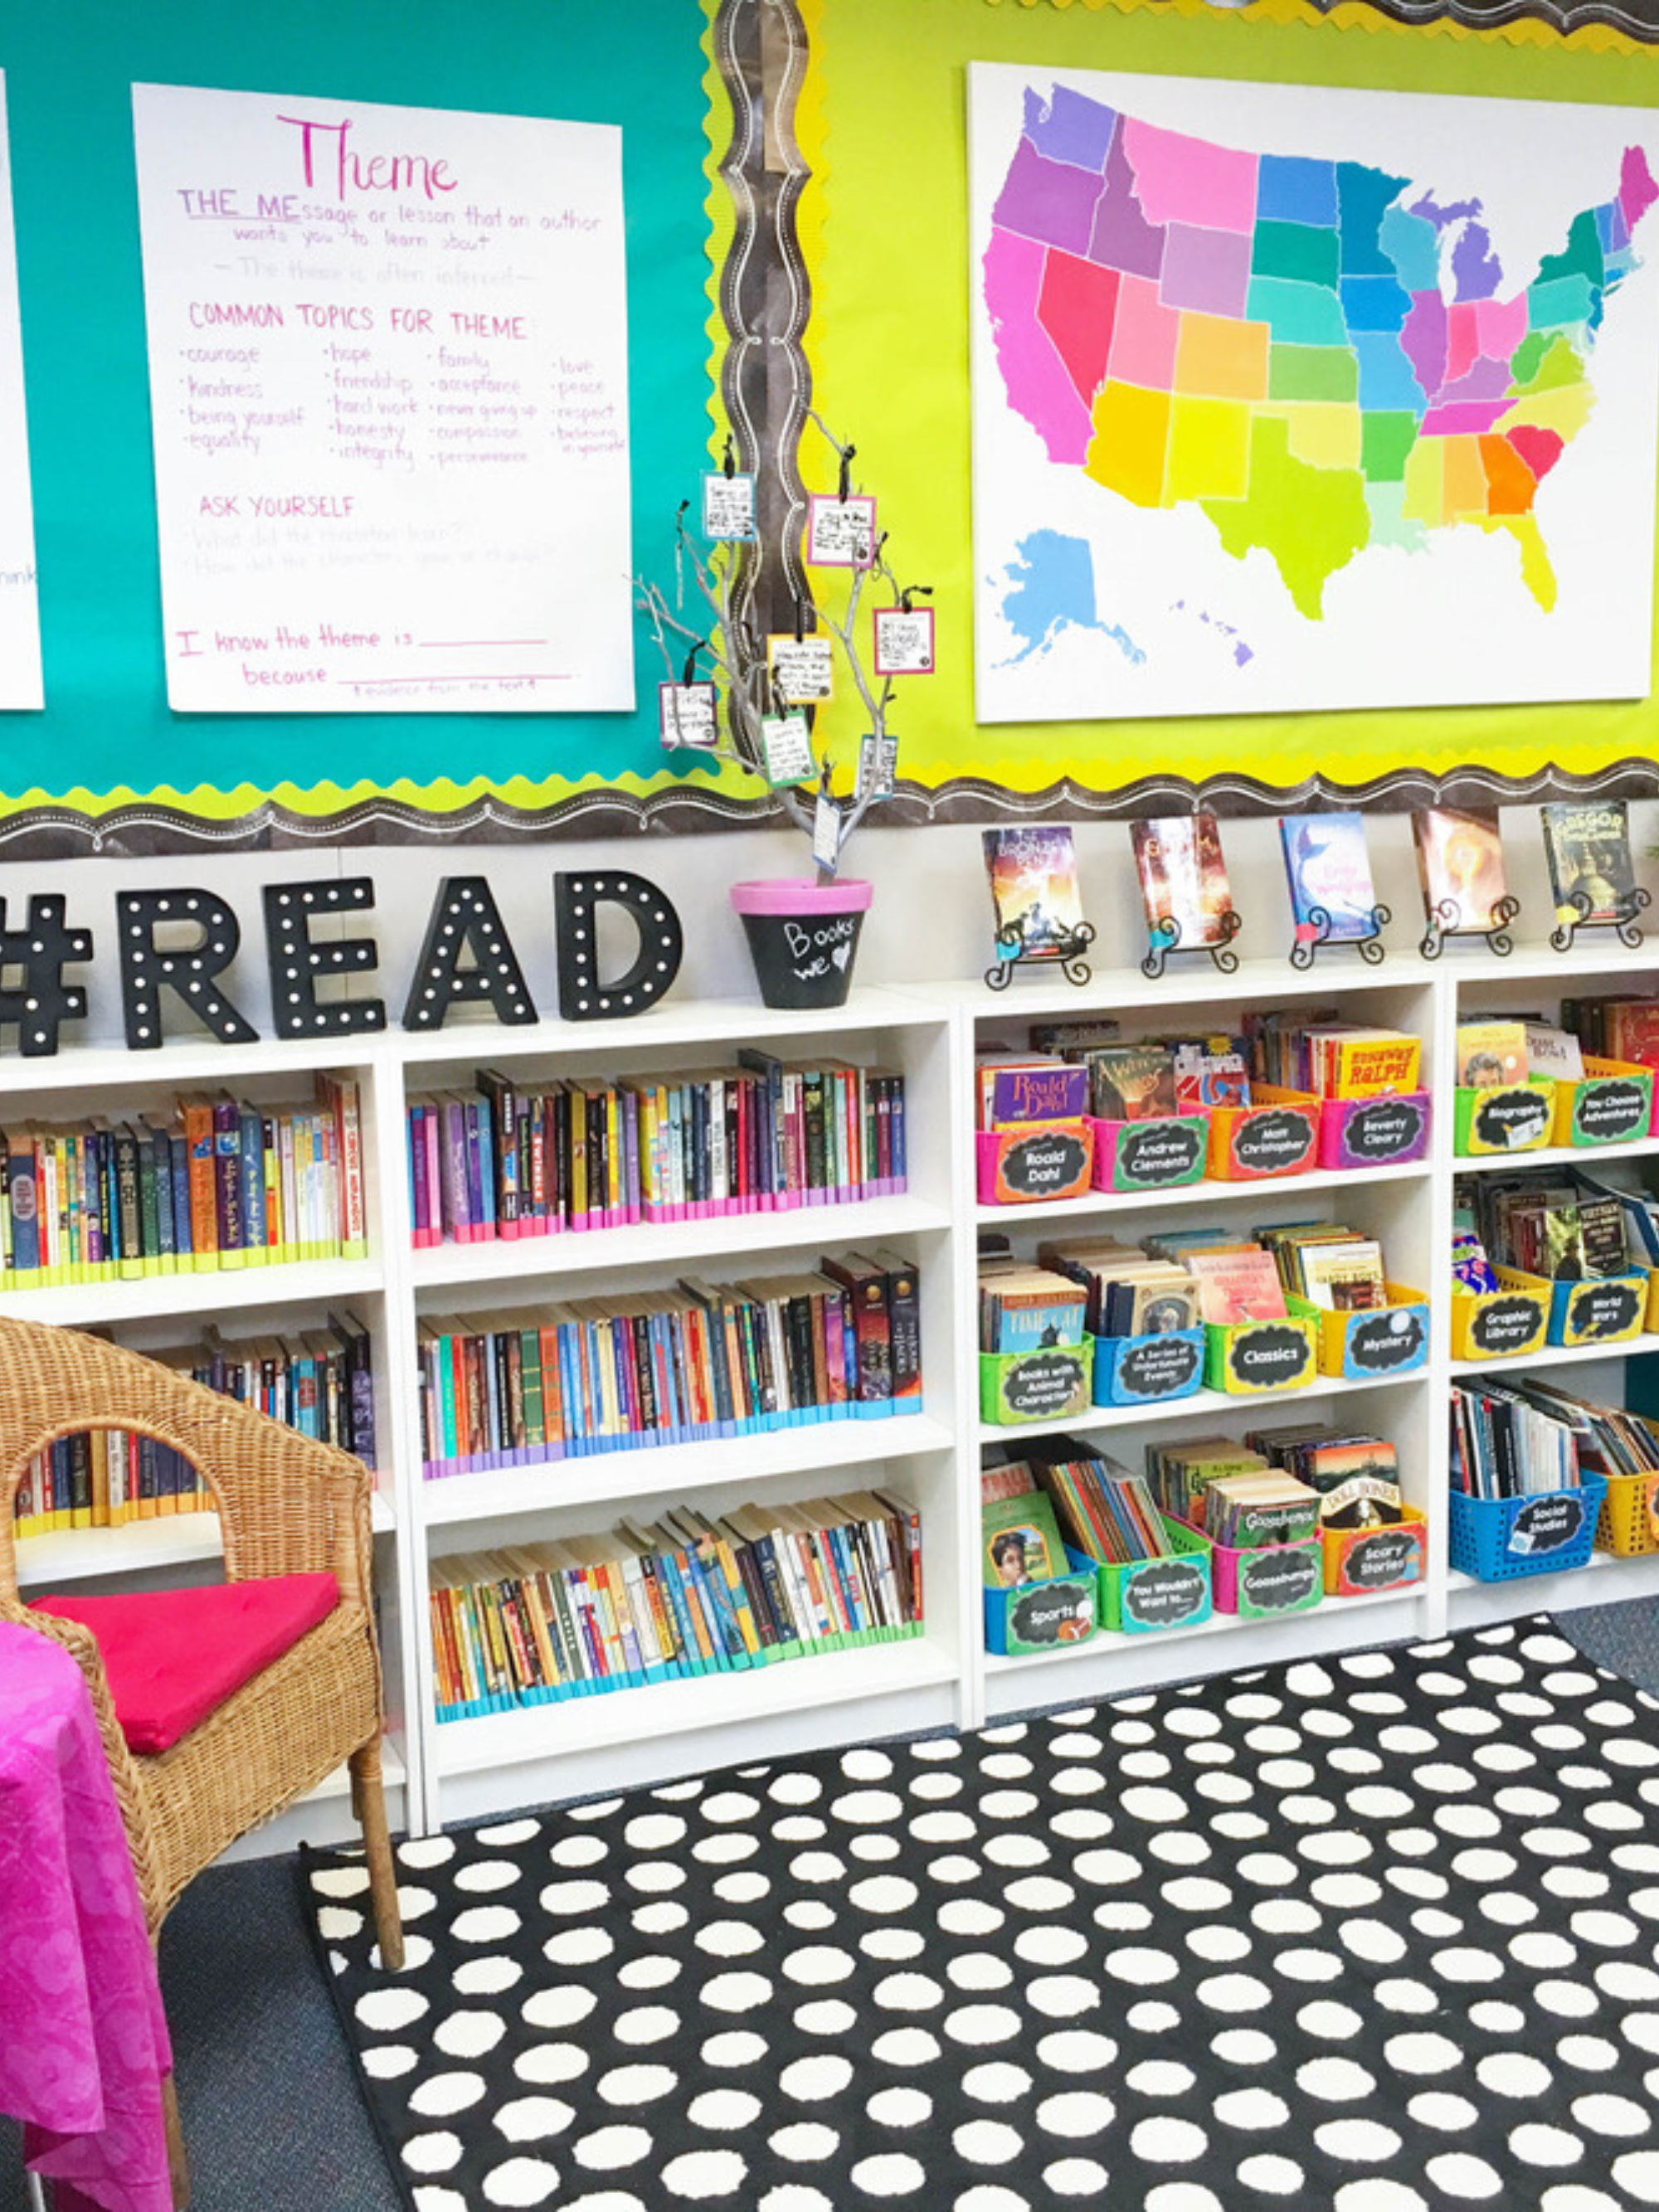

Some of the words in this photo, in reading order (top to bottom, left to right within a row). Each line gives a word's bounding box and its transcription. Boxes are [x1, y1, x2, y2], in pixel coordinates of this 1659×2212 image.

[277, 114, 459, 201] Theme
[177, 189, 239, 217] THE
[368, 207, 392, 224] or
[398, 204, 456, 226] lesson
[466, 205, 503, 228] that
[509, 213, 532, 227] an
[539, 210, 603, 231] author
[233, 224, 287, 244] wants
[384, 231, 429, 248] learn
[189, 302, 285, 328] COMMON
[295, 304, 374, 331] TOPICS
[390, 308, 434, 334] FOR
[450, 312, 528, 340] THEME
[199, 496, 241, 518] ASK
[250, 496, 355, 518] YOURSELF
[175, 630, 204, 656] I
[215, 629, 270, 651] know
[275, 628, 312, 648] the
[319, 623, 382, 647] theme
[394, 633, 415, 646] is
[241, 661, 328, 687] because
[784, 918, 854, 959] Books
[793, 956, 830, 980] we
[1349, 1062, 1408, 1086] RALPH
[1013, 1073, 1070, 1101] Roald
[1022, 1092, 1068, 1118] Dahl
[1362, 1116, 1408, 1133] Beverly
[1240, 1139, 1306, 1156] Christopher
[1363, 1131, 1404, 1148] Cleary
[1024, 1150, 1067, 1167] Roald
[1136, 1141, 1187, 1158] Andrew
[1131, 1156, 1190, 1172] Clements
[1027, 1168, 1061, 1184] Dahl
[1485, 1309, 1532, 1326] Graphic
[1485, 1325, 1529, 1340] Library
[1362, 1334, 1412, 1352] Mystery
[1243, 1347, 1298, 1364] Classics
[1017, 1367, 1050, 1383] Books
[1052, 1364, 1075, 1378] with
[1027, 1378, 1065, 1393] Animal
[1365, 1544, 1404, 1561] Scary
[1360, 1559, 1405, 1577] Stories
[1244, 1568, 1316, 1588] Goosebumps
[1030, 1605, 1073, 1626] Sports
